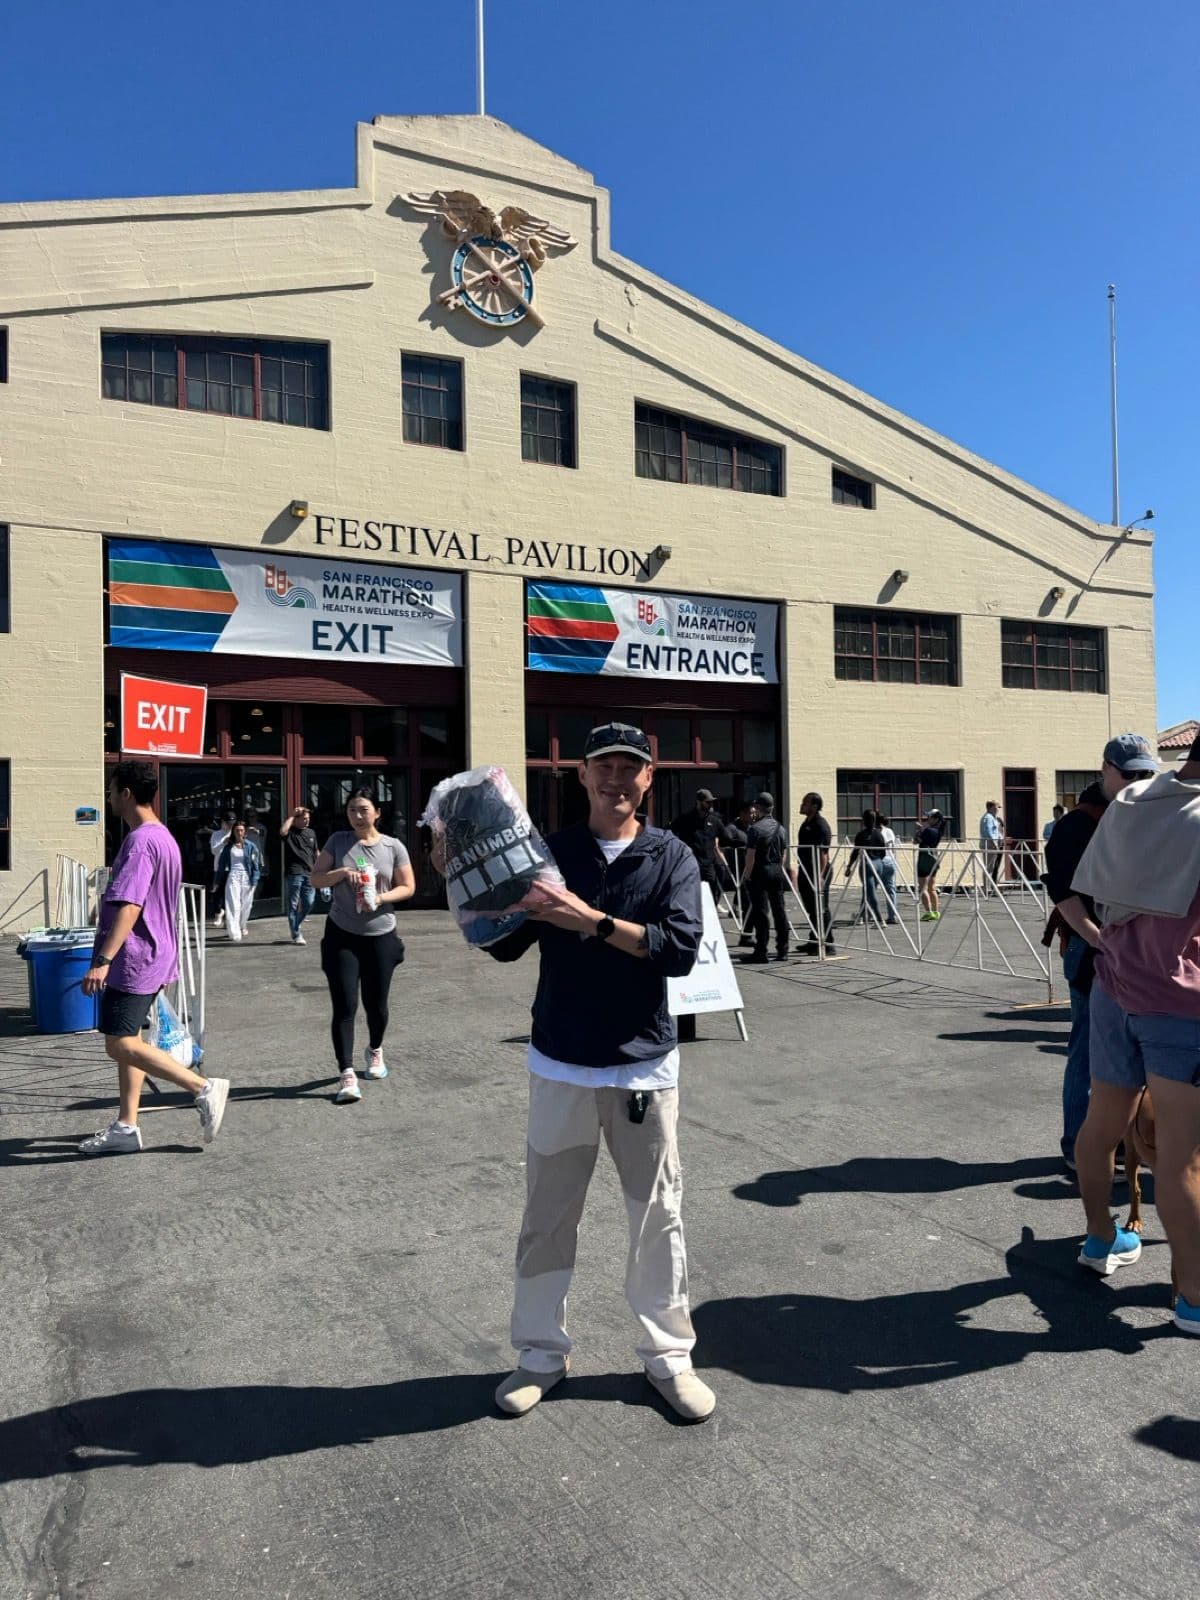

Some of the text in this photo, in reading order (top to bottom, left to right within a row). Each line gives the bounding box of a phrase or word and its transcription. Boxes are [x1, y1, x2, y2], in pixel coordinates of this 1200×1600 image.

[313, 514, 652, 578] FESTIVAL PAVILION
[322, 570, 434, 591] SAN FRANCISCO
[322, 584, 433, 606] MARATHON
[322, 603, 434, 619] HEALTH & WELLNESS EXPO
[678, 604, 757, 620] SAN FRANCISCO
[677, 615, 756, 634] MARATHON
[312, 620, 394, 655] EXIT
[676, 631, 700, 641] HEALTH
[700, 633, 706, 641] &
[706, 634, 738, 643] WELLNESS
[627, 642, 766, 676] ENTRANCE
[137, 700, 192, 734] EXIT
[697, 940, 718, 964] LY
